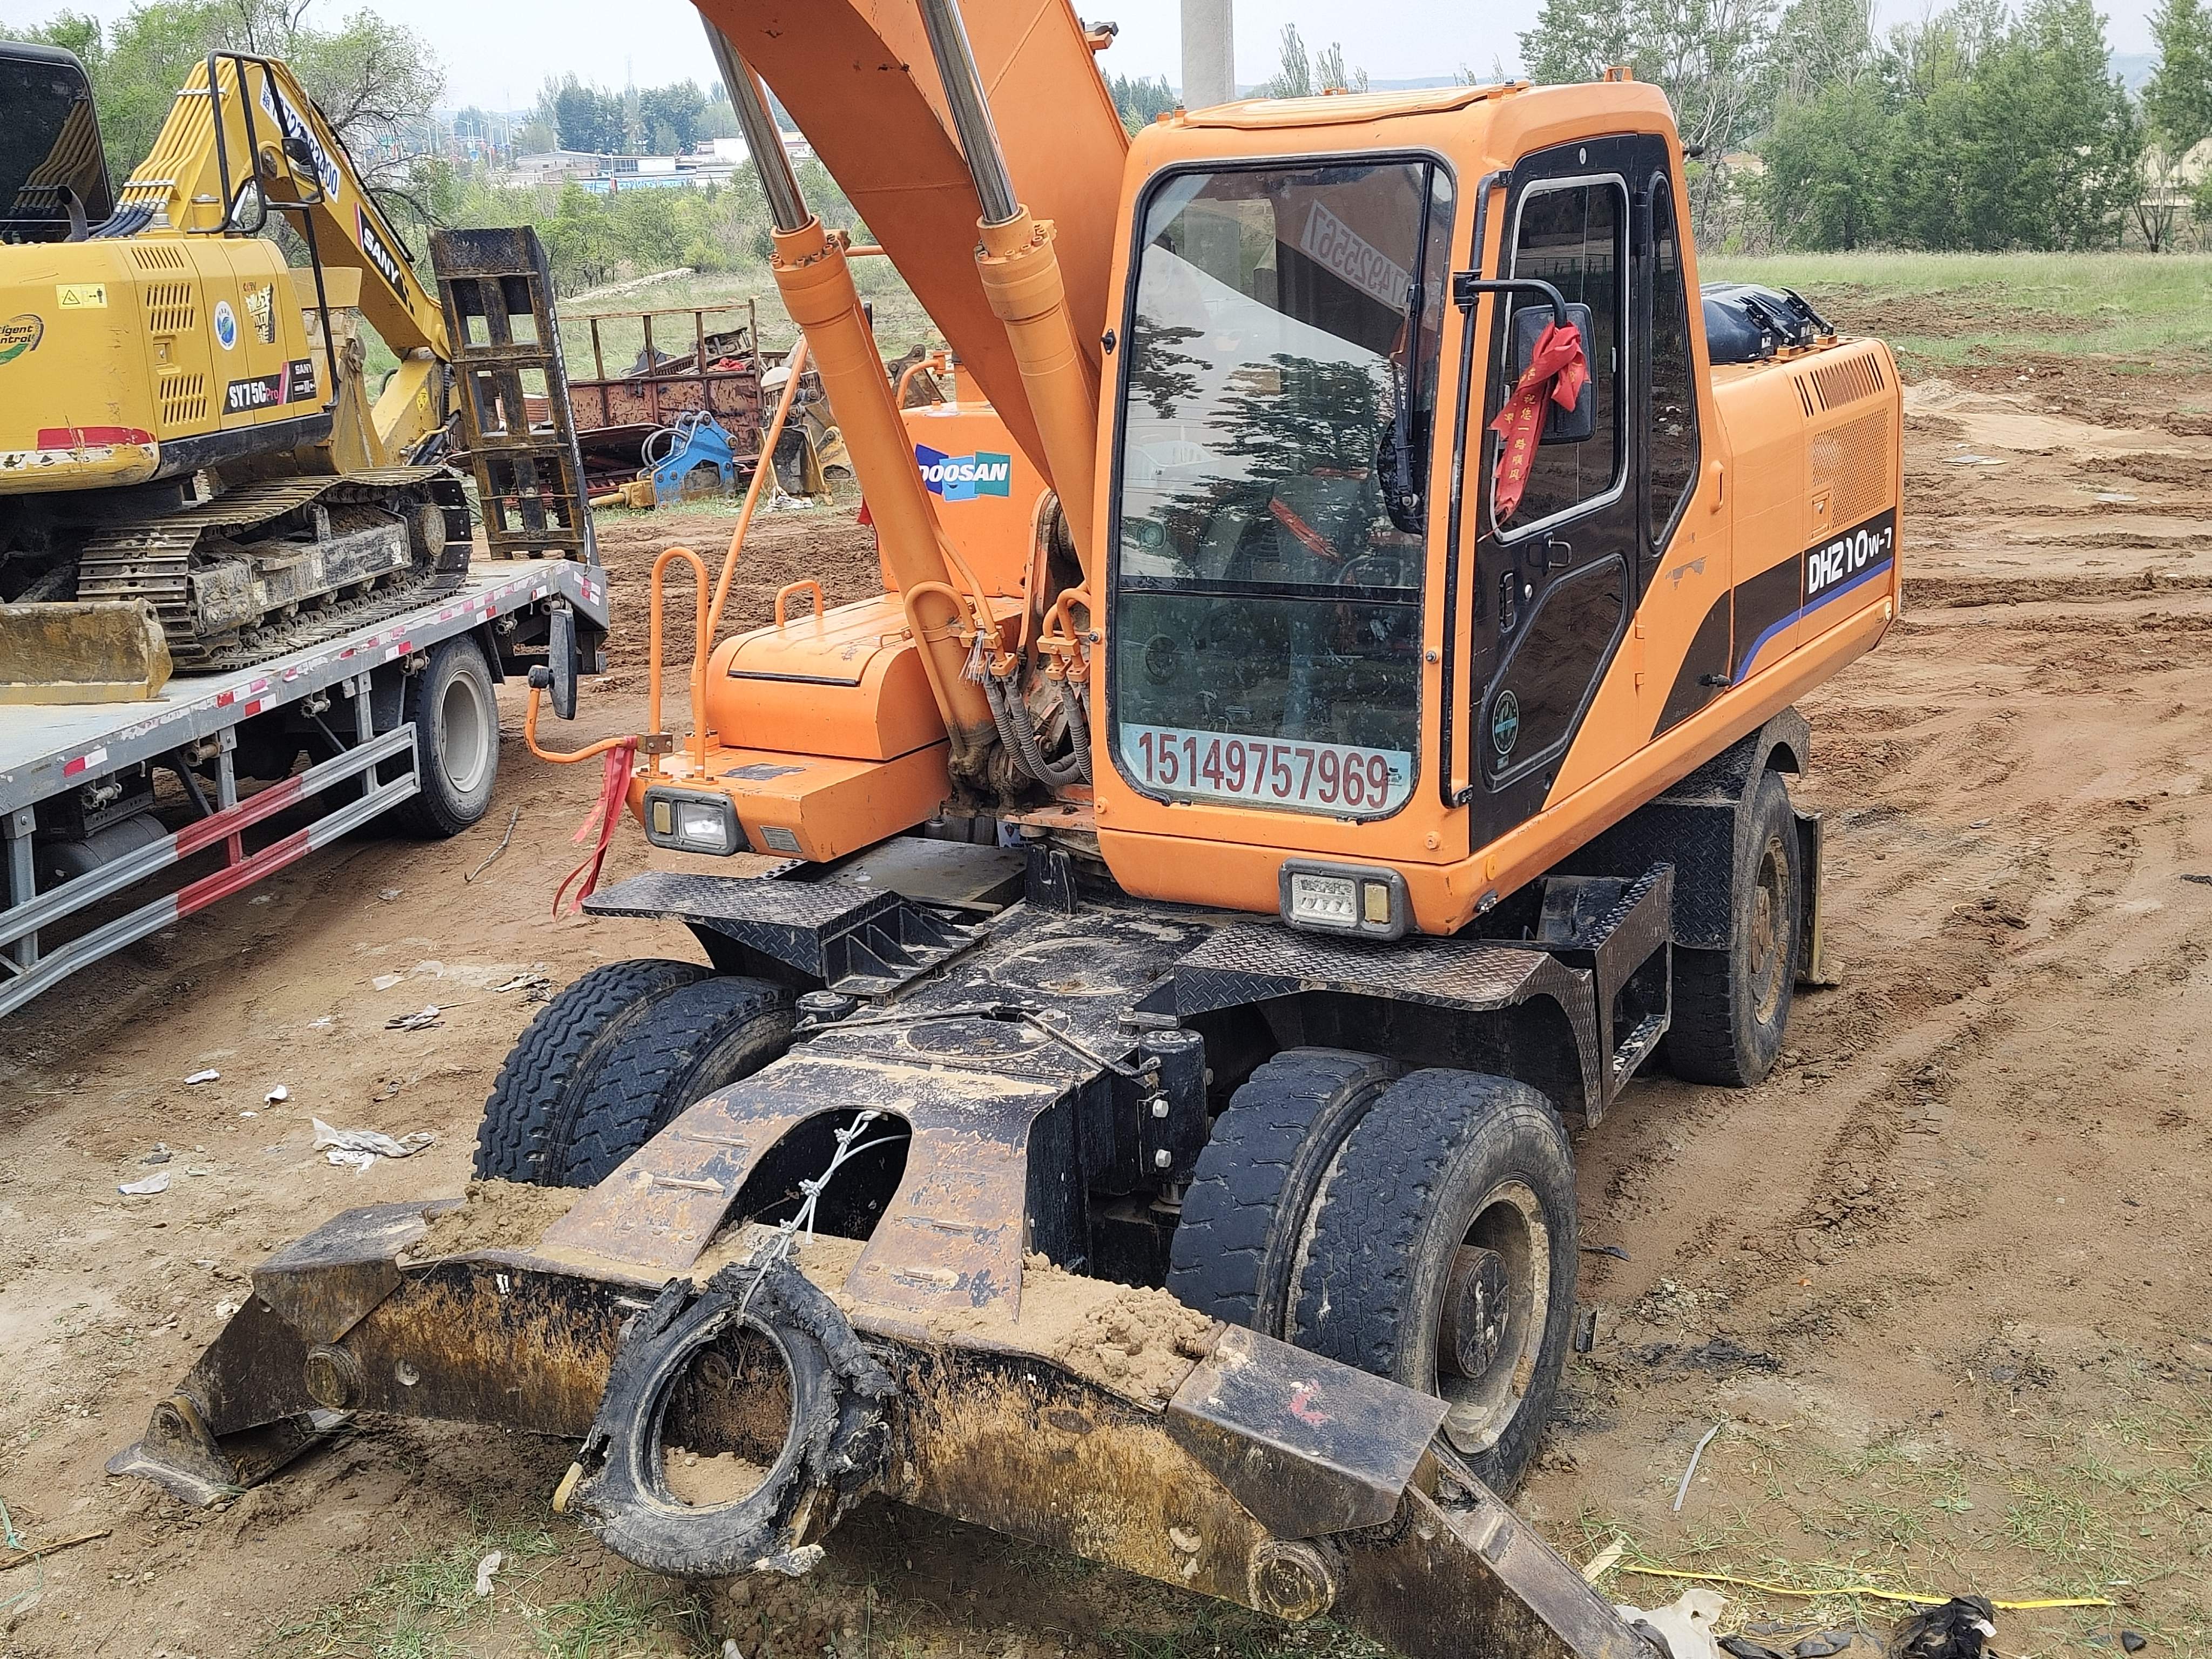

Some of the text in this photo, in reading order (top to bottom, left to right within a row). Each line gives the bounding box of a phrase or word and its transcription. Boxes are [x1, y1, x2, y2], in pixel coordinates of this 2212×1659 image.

[364, 228, 400, 284] SANY
[0, 325, 33, 336] igent
[229, 381, 279, 408] SY75C Pro
[919, 463, 1008, 482] DOOSAN
[1139, 732, 1388, 809] 15149757969
